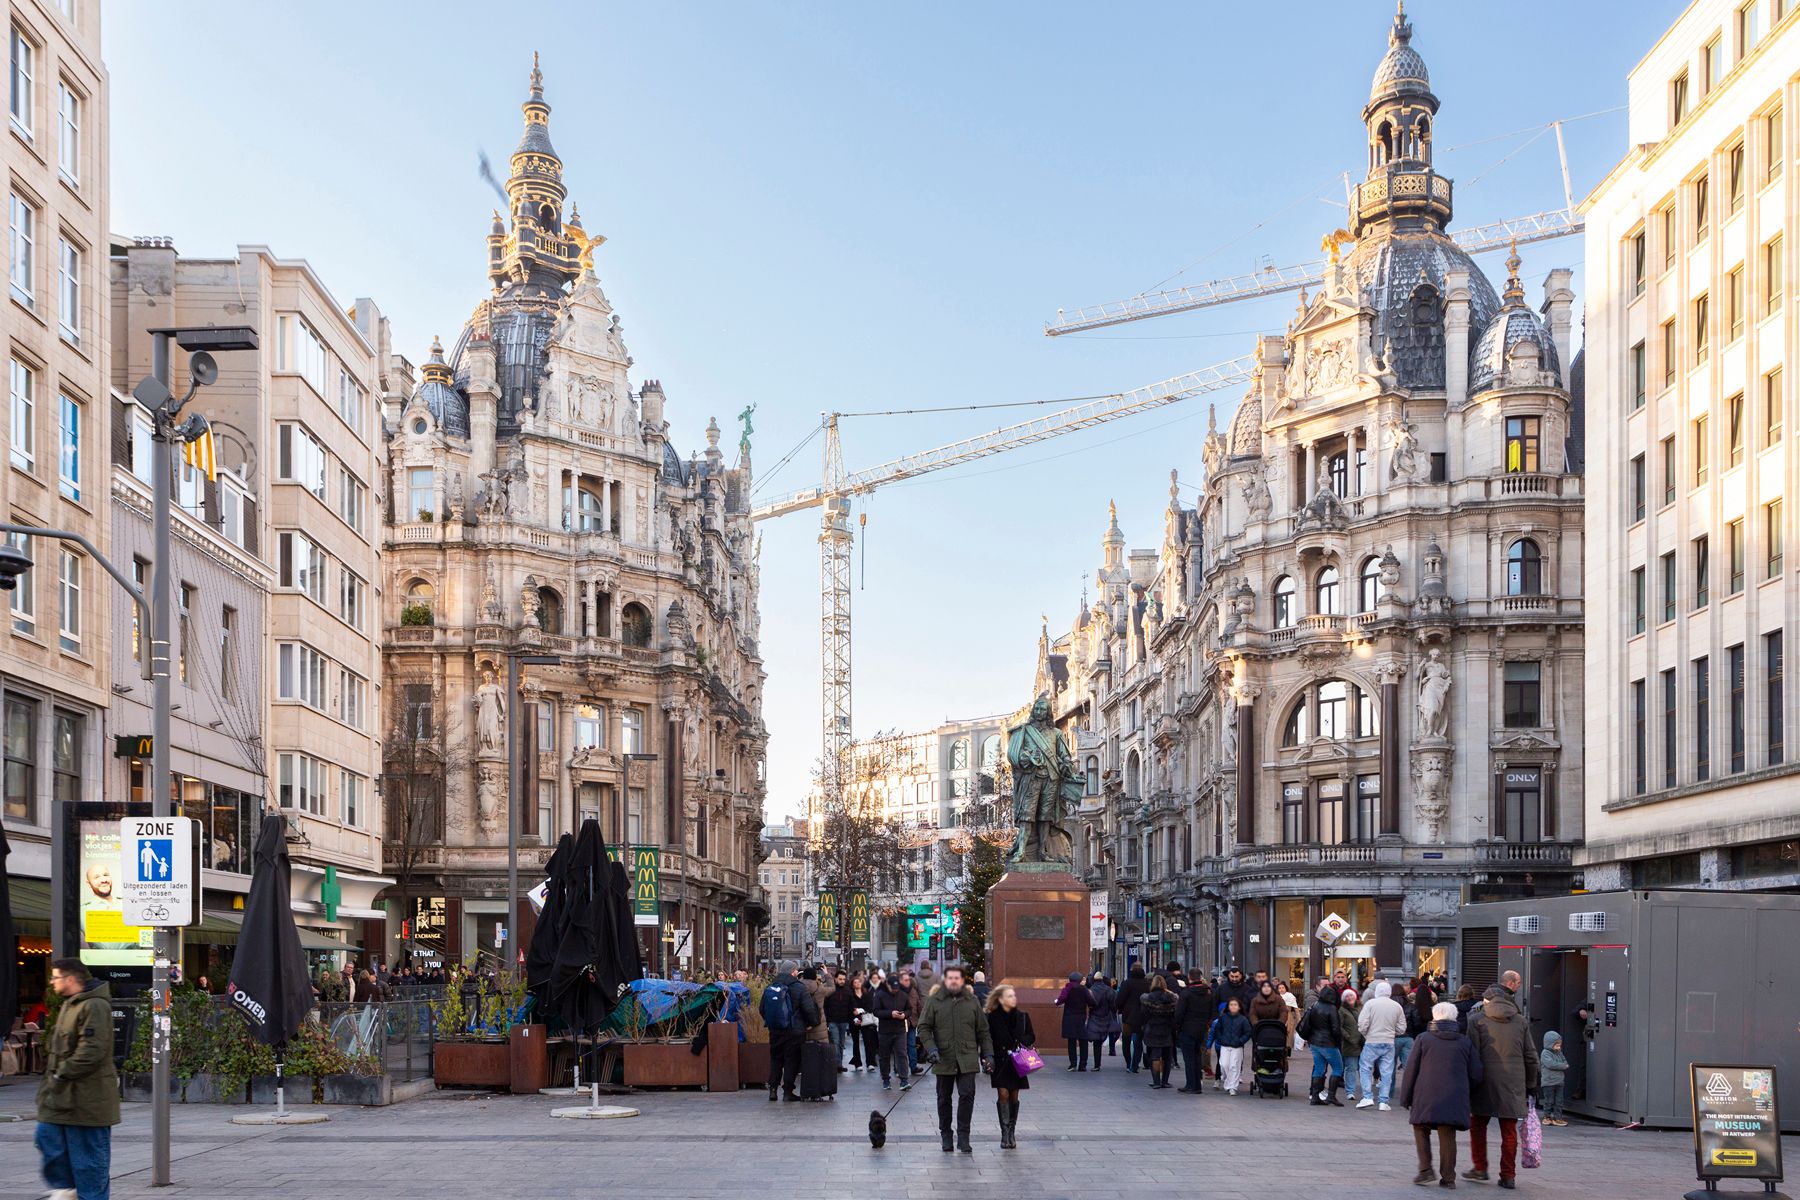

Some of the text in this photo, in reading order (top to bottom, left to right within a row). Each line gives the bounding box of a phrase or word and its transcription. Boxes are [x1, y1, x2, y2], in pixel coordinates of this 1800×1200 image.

[1506, 773, 1537, 782] ONLY
[1284, 788, 1302, 796] ONL
[136, 823, 174, 836] ZONE
[1343, 932, 1367, 941] NLY
[234, 990, 266, 1024] OMER.
[1715, 1121, 1761, 1130] MUSEUM
